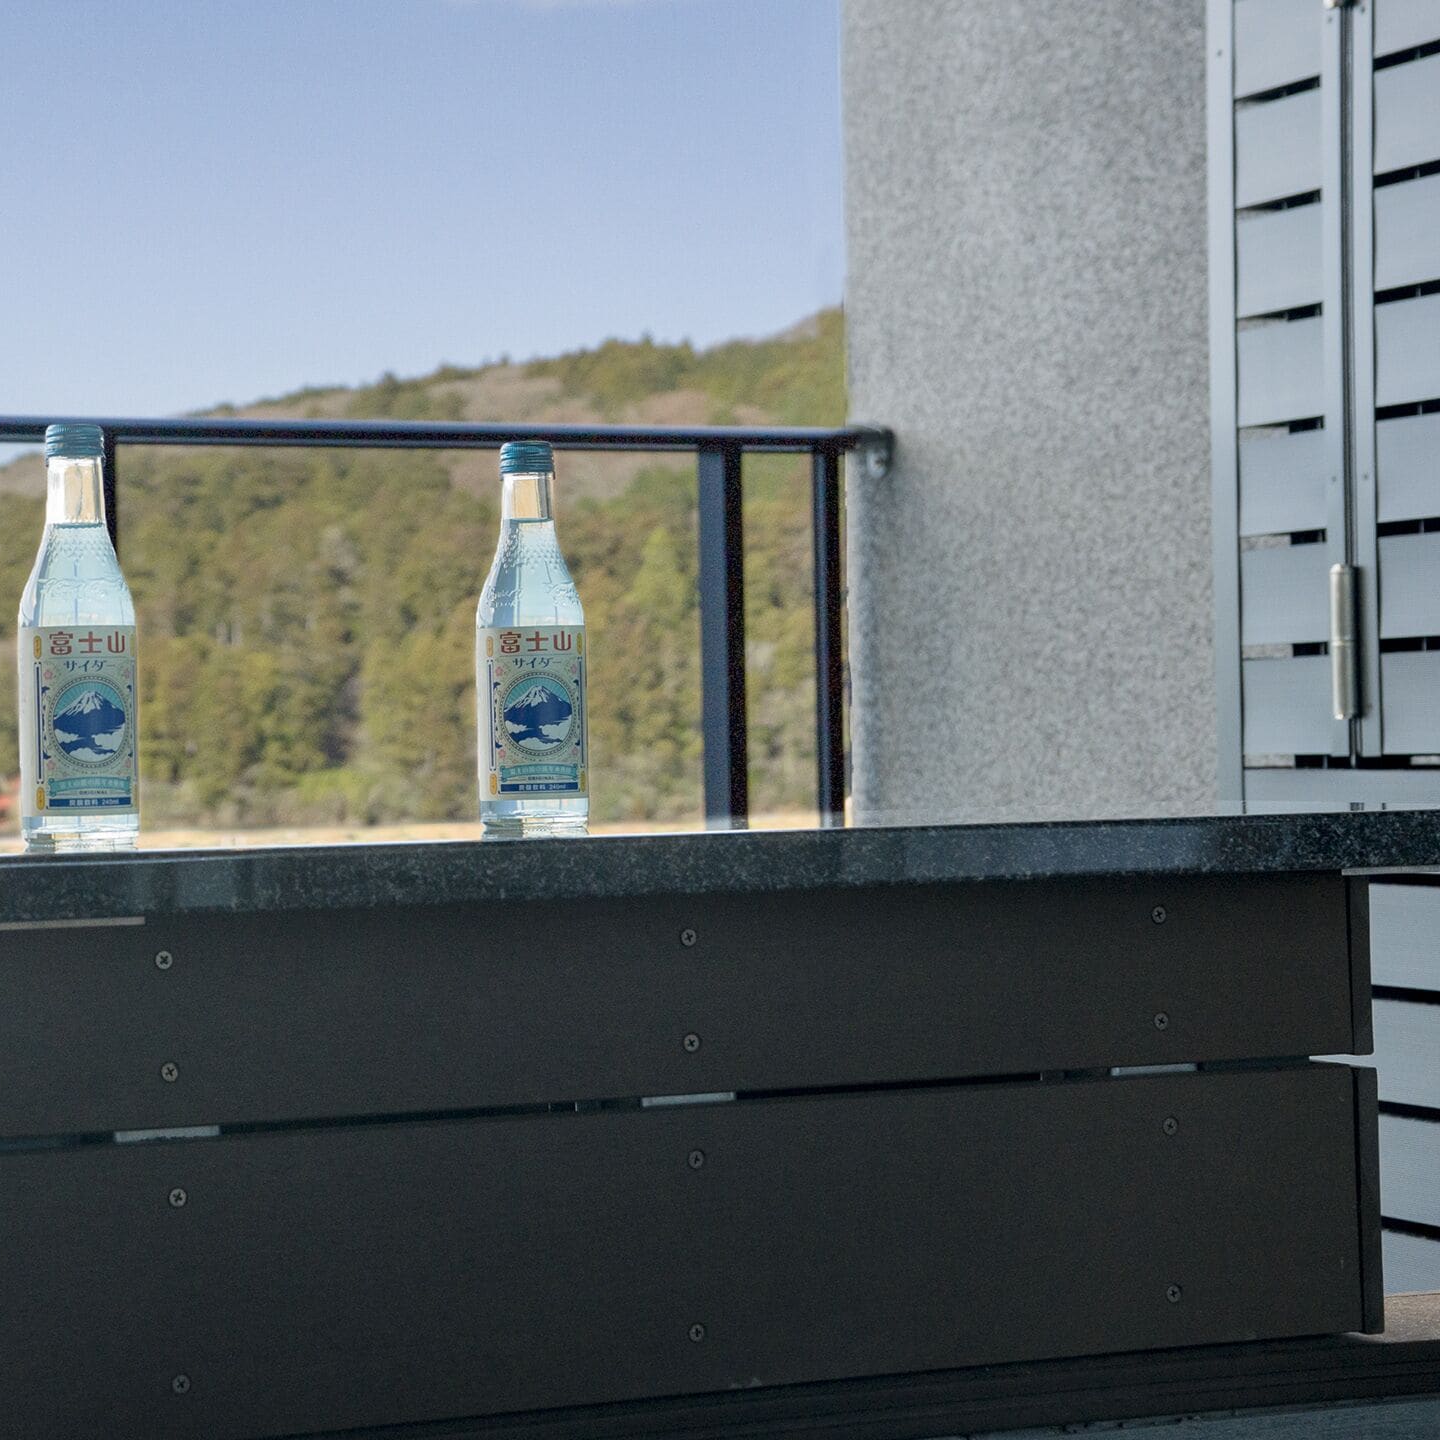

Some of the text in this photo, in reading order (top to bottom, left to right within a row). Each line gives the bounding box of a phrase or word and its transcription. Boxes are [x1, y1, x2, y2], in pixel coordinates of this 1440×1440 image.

[49, 631, 125, 655] 富士山
[500, 630, 571, 654] 富士山
[63, 659, 115, 672] サイダー
[512, 657, 562, 669] サイダー
